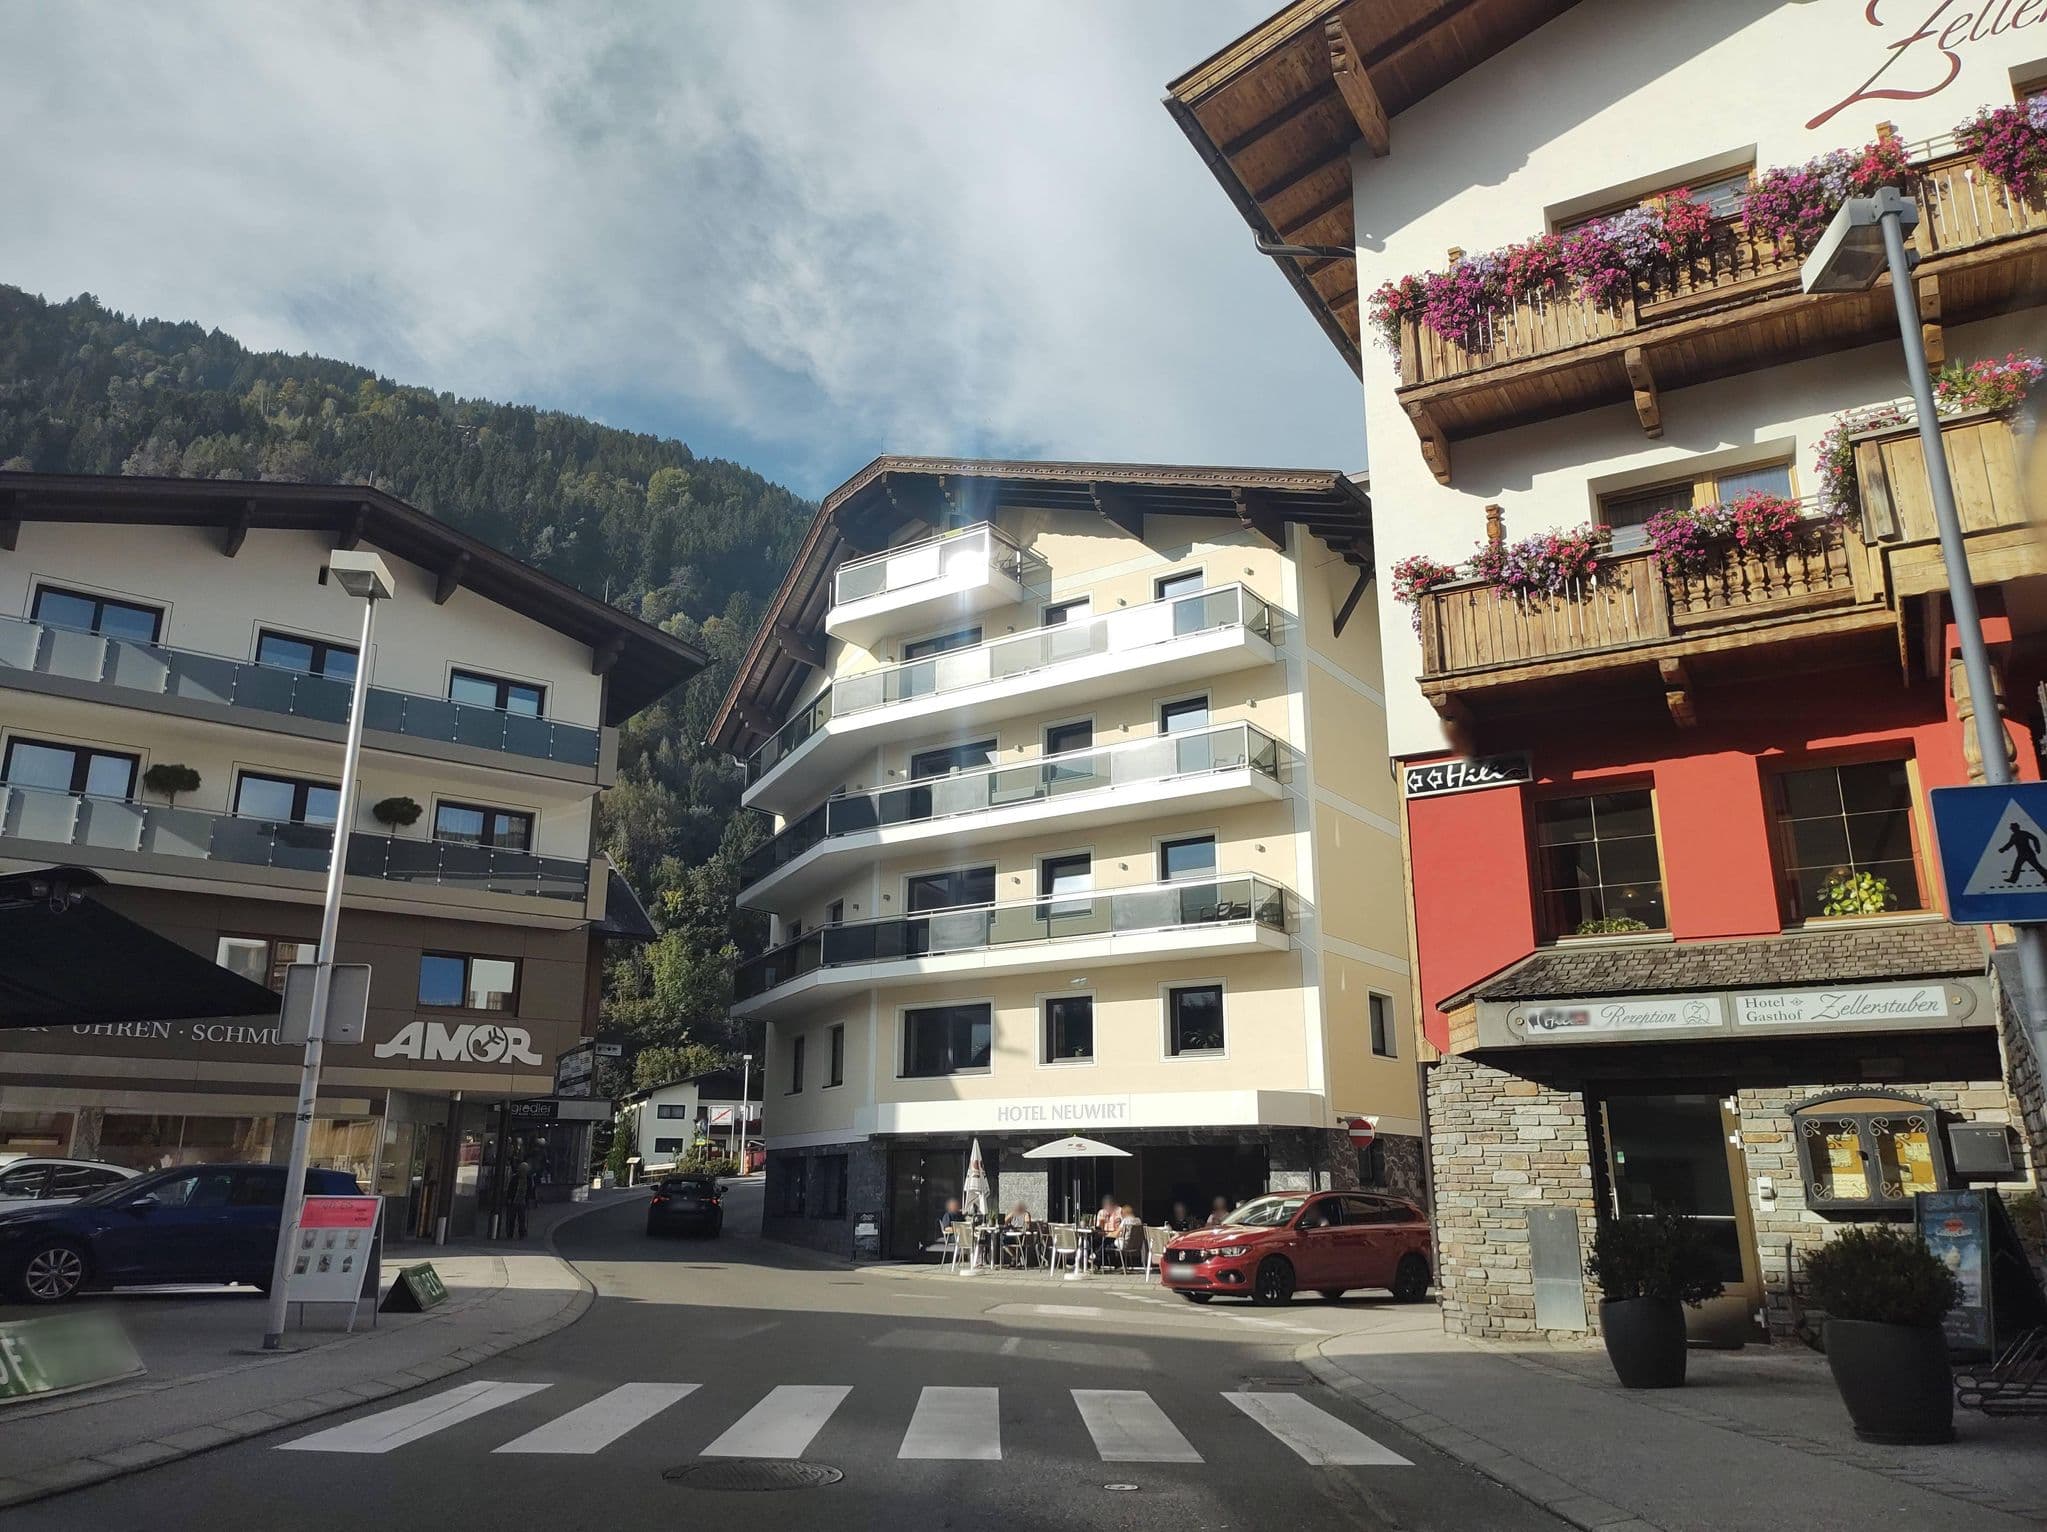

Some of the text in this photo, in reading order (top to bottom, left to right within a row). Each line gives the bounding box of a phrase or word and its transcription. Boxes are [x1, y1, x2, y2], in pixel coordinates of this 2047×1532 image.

[1805, 0, 2047, 129] Zelle
[1744, 996, 1785, 1009] Hotel
[1810, 990, 1939, 1021] Zellerstuben
[1745, 1009, 1803, 1023] Gasthof
[374, 1021, 542, 1066] AMOR
[998, 1102, 1127, 1122] HOTEL NEUWIRT
